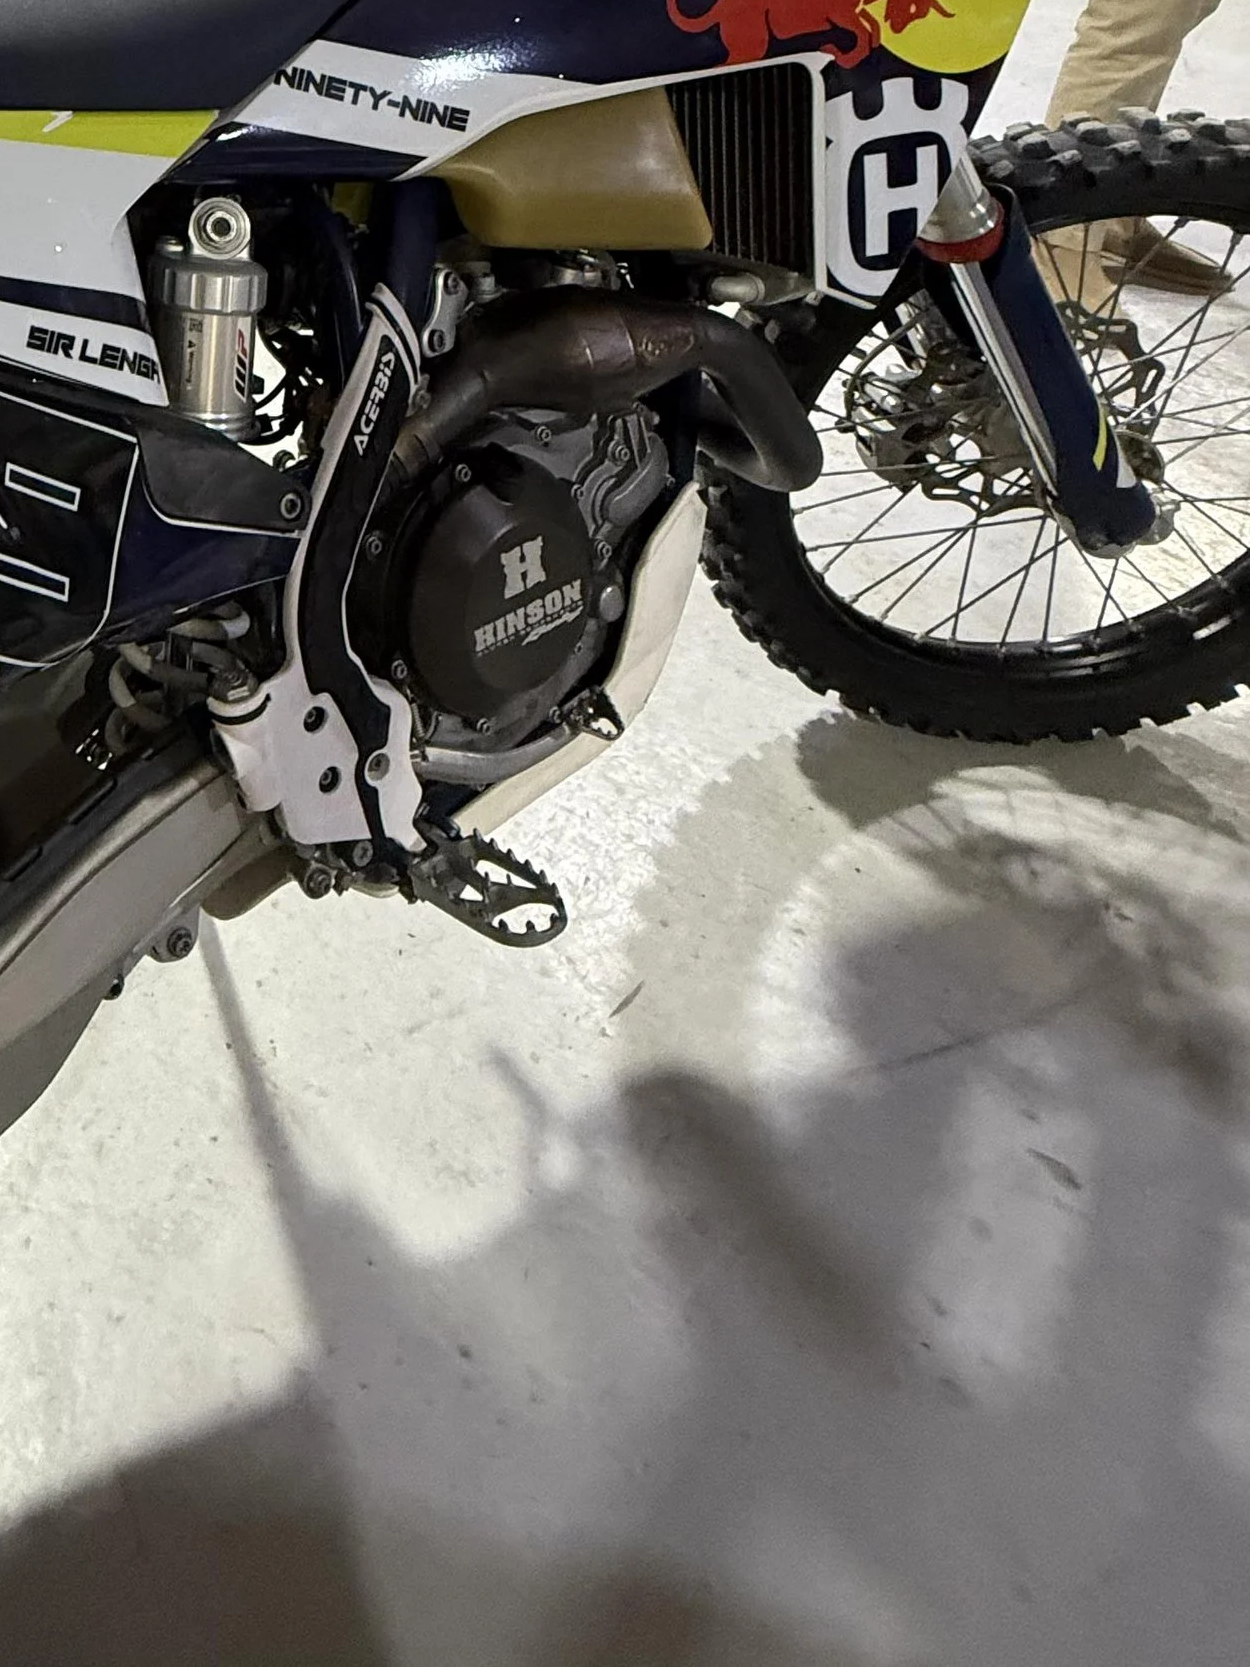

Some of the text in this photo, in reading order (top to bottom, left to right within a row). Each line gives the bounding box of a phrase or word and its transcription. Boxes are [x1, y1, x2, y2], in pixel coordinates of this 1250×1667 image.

[274, 66, 470, 132] NINETY-NINE
[26, 325, 76, 359] SIR
[353, 352, 396, 456] ACERBIS
[500, 535, 547, 600] H
[473, 578, 582, 652] HINSON
